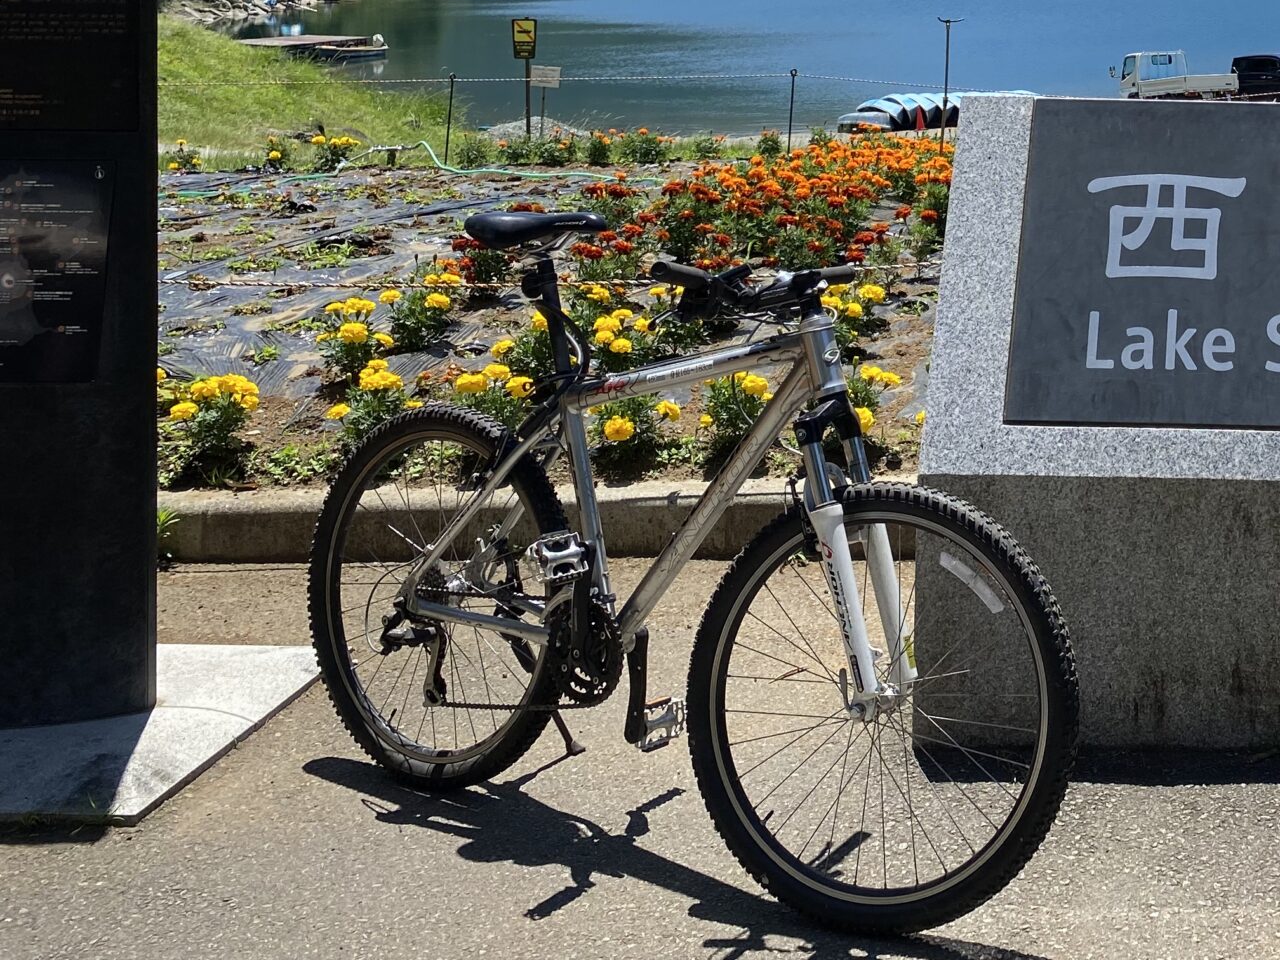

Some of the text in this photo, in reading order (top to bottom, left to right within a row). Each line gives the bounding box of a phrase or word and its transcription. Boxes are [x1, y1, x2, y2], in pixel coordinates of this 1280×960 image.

[1085, 308, 1236, 373] Lake
[668, 435, 760, 570] ANCHOR
[827, 562, 853, 650] ANCHOR
